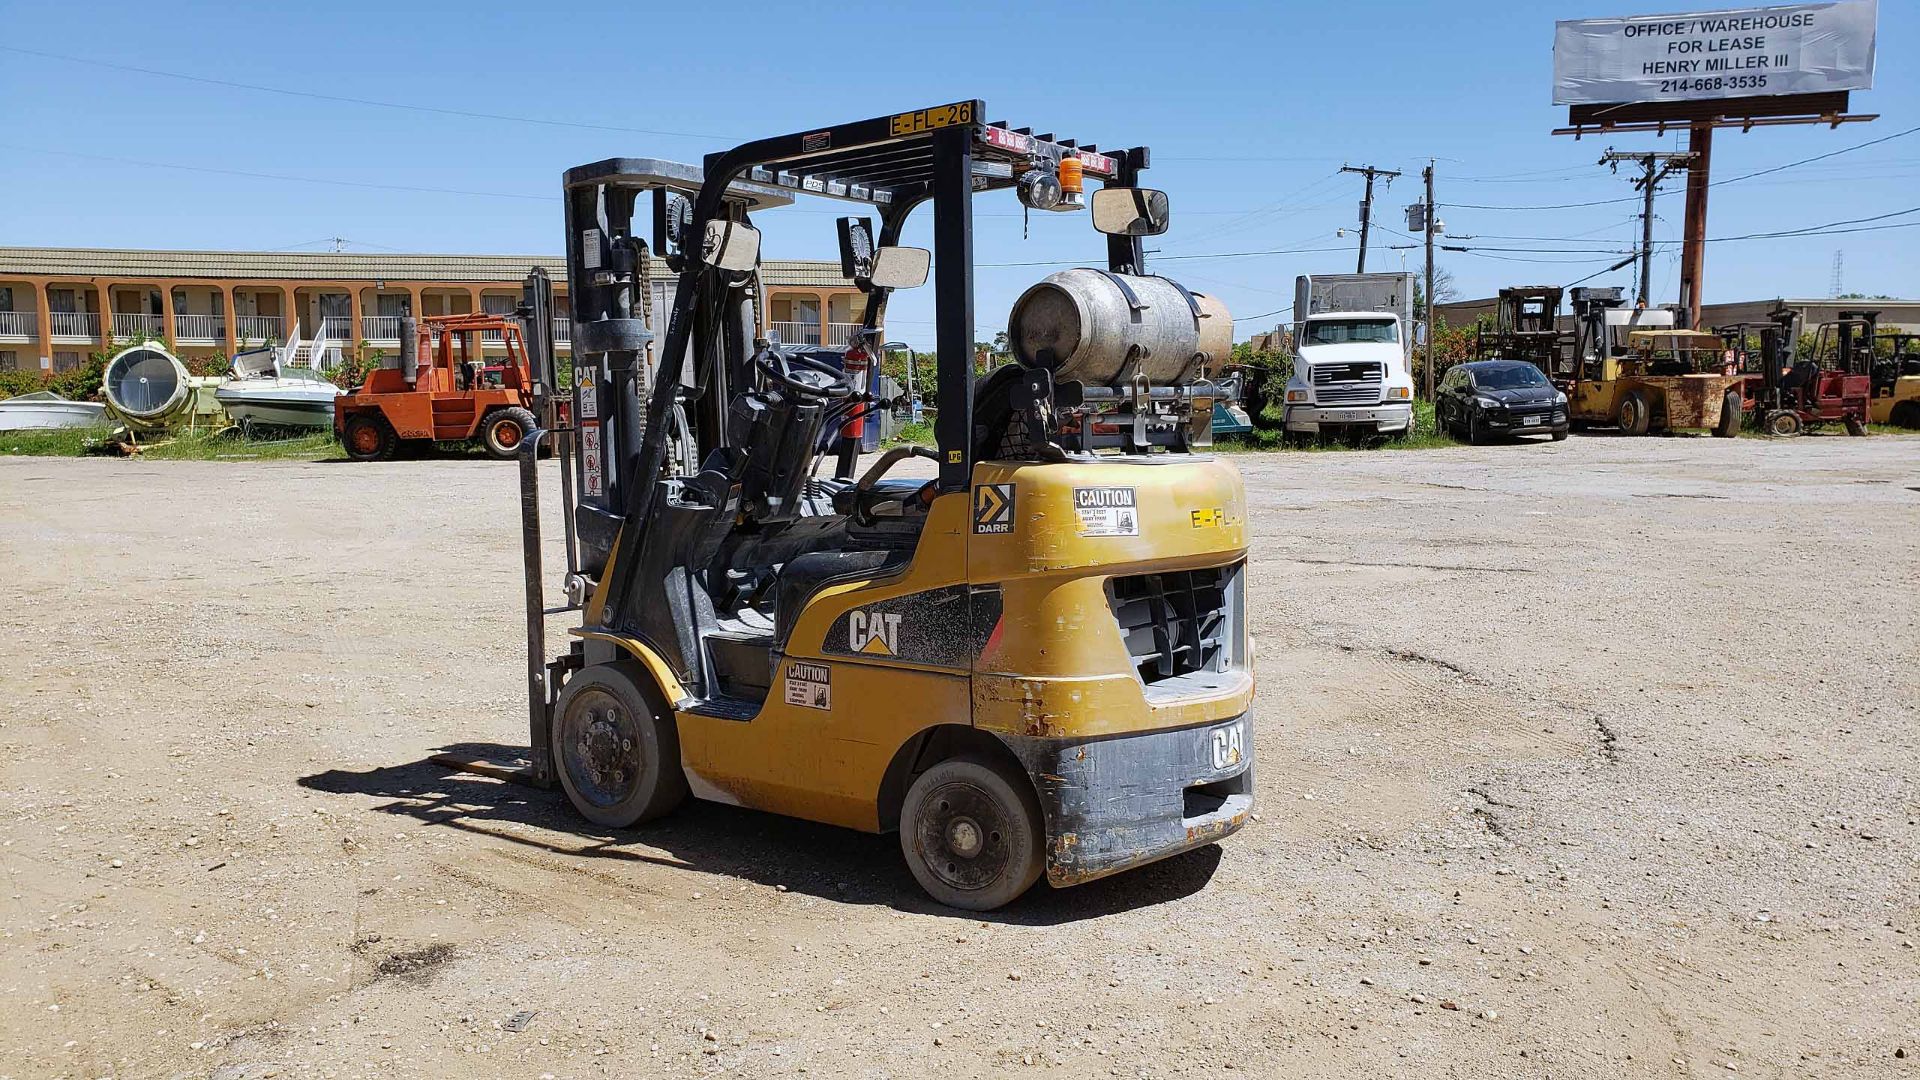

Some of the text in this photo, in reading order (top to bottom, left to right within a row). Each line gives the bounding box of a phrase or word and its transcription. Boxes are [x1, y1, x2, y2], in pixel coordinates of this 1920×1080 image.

[1624, 13, 1815, 38] OFFICE / WAREHOUSE
[1668, 36, 1765, 54] FOR LEASE
[1643, 54, 1788, 75] HENRY MILLER III
[1660, 75, 1768, 93] 214-668-3535
[891, 103, 970, 135] E-FL-26
[575, 366, 597, 387] CAT
[949, 452, 961, 461] LPG
[1079, 489, 1133, 506] CAUTION
[978, 523, 1009, 534] DARR
[849, 610, 902, 656] CAT
[788, 664, 828, 682] CAUTION
